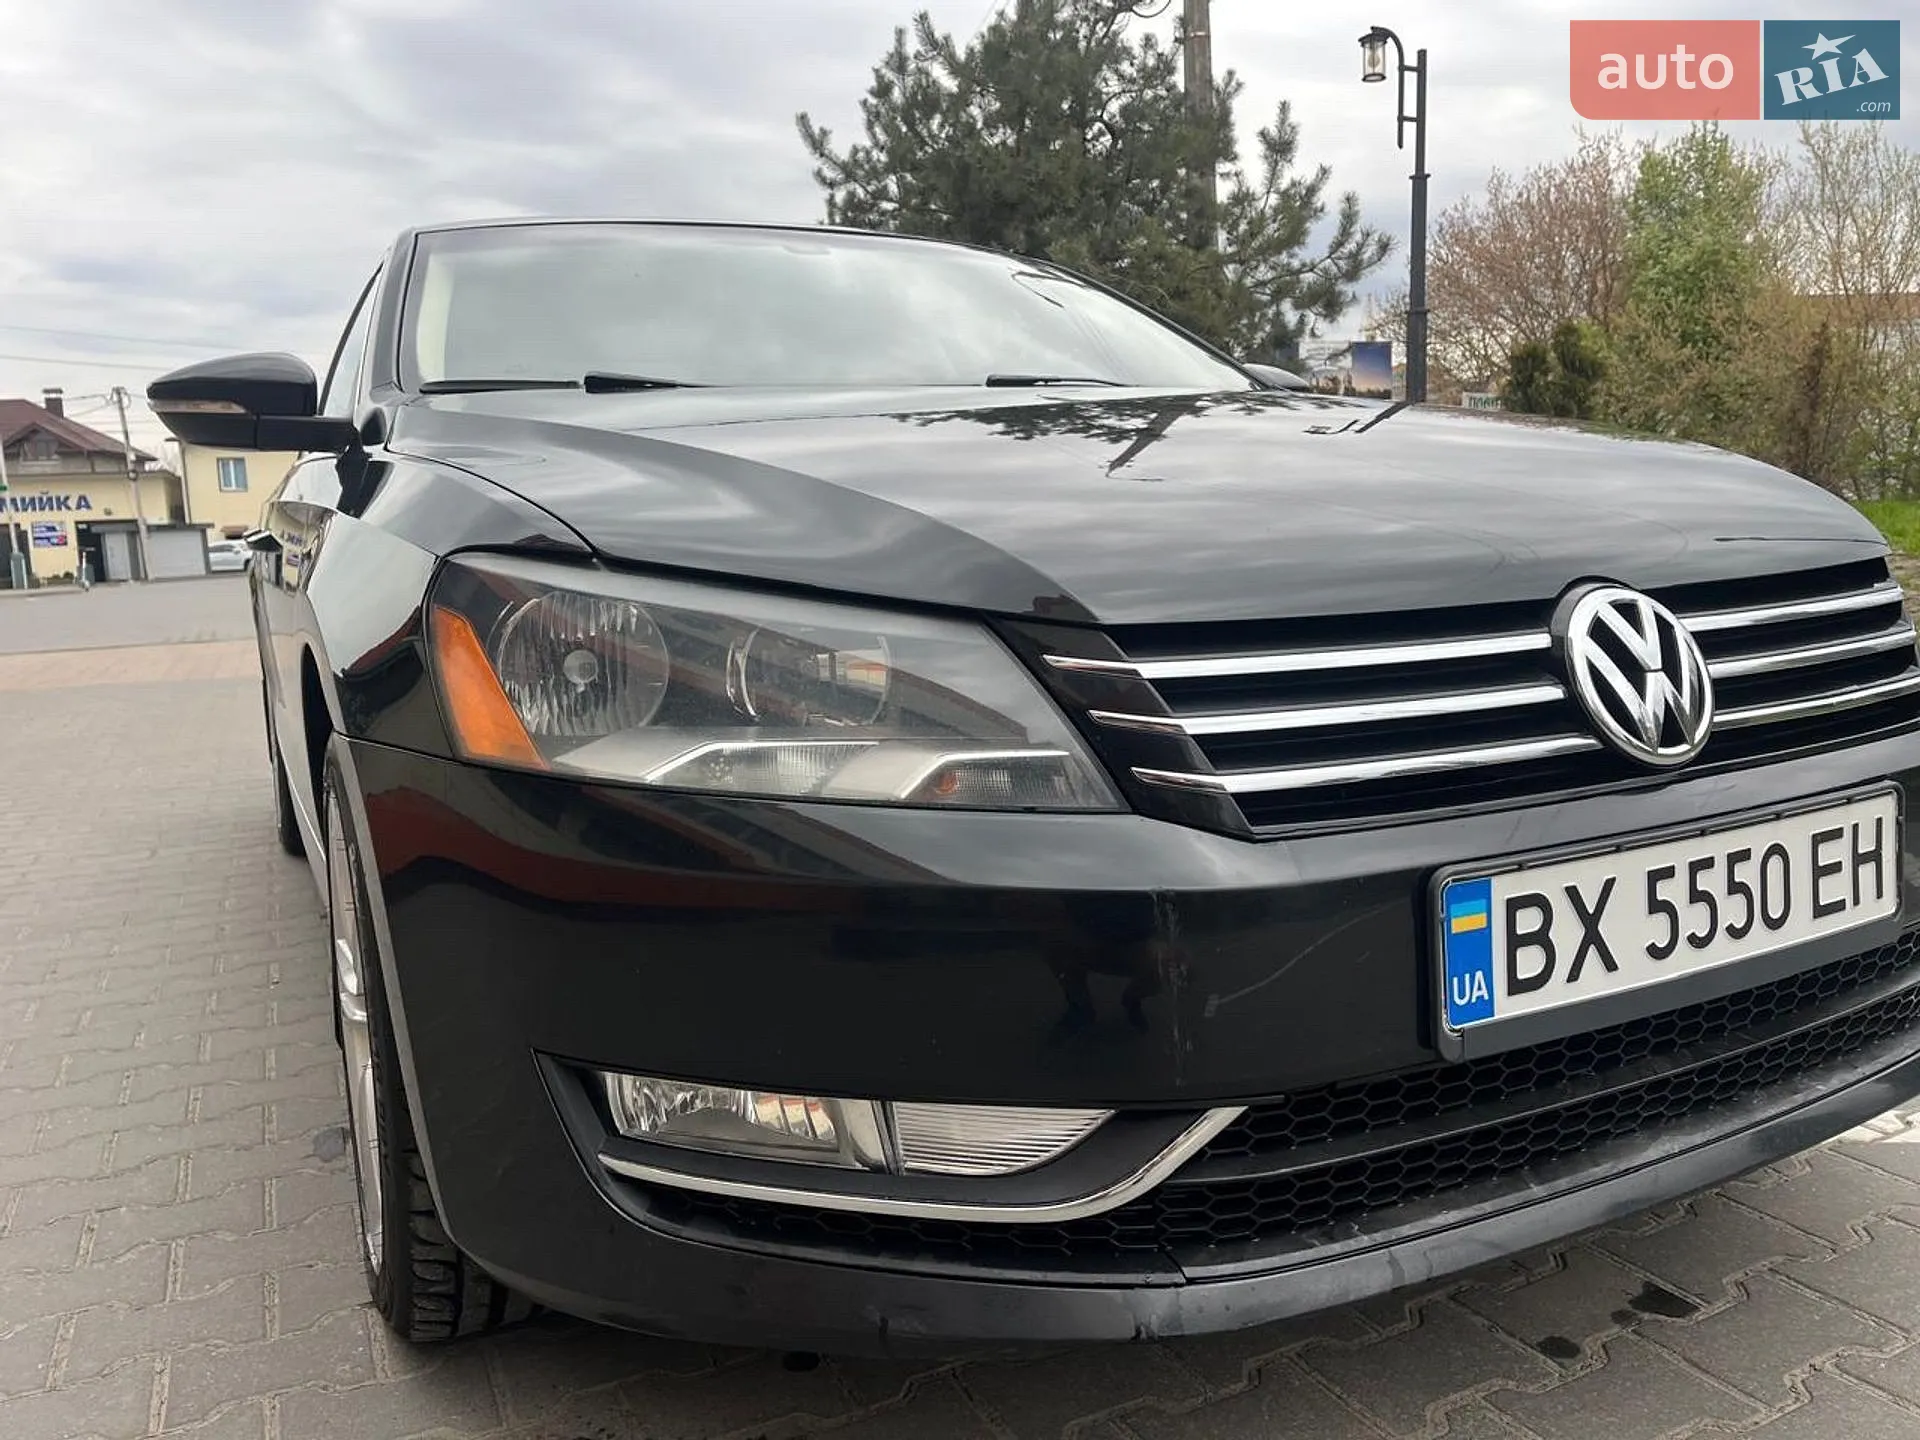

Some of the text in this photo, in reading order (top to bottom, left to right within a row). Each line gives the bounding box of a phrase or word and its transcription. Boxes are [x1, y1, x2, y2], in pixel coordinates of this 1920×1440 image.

[1506, 816, 1884, 997] BX 5550 EH
[1452, 970, 1490, 1007] UA
